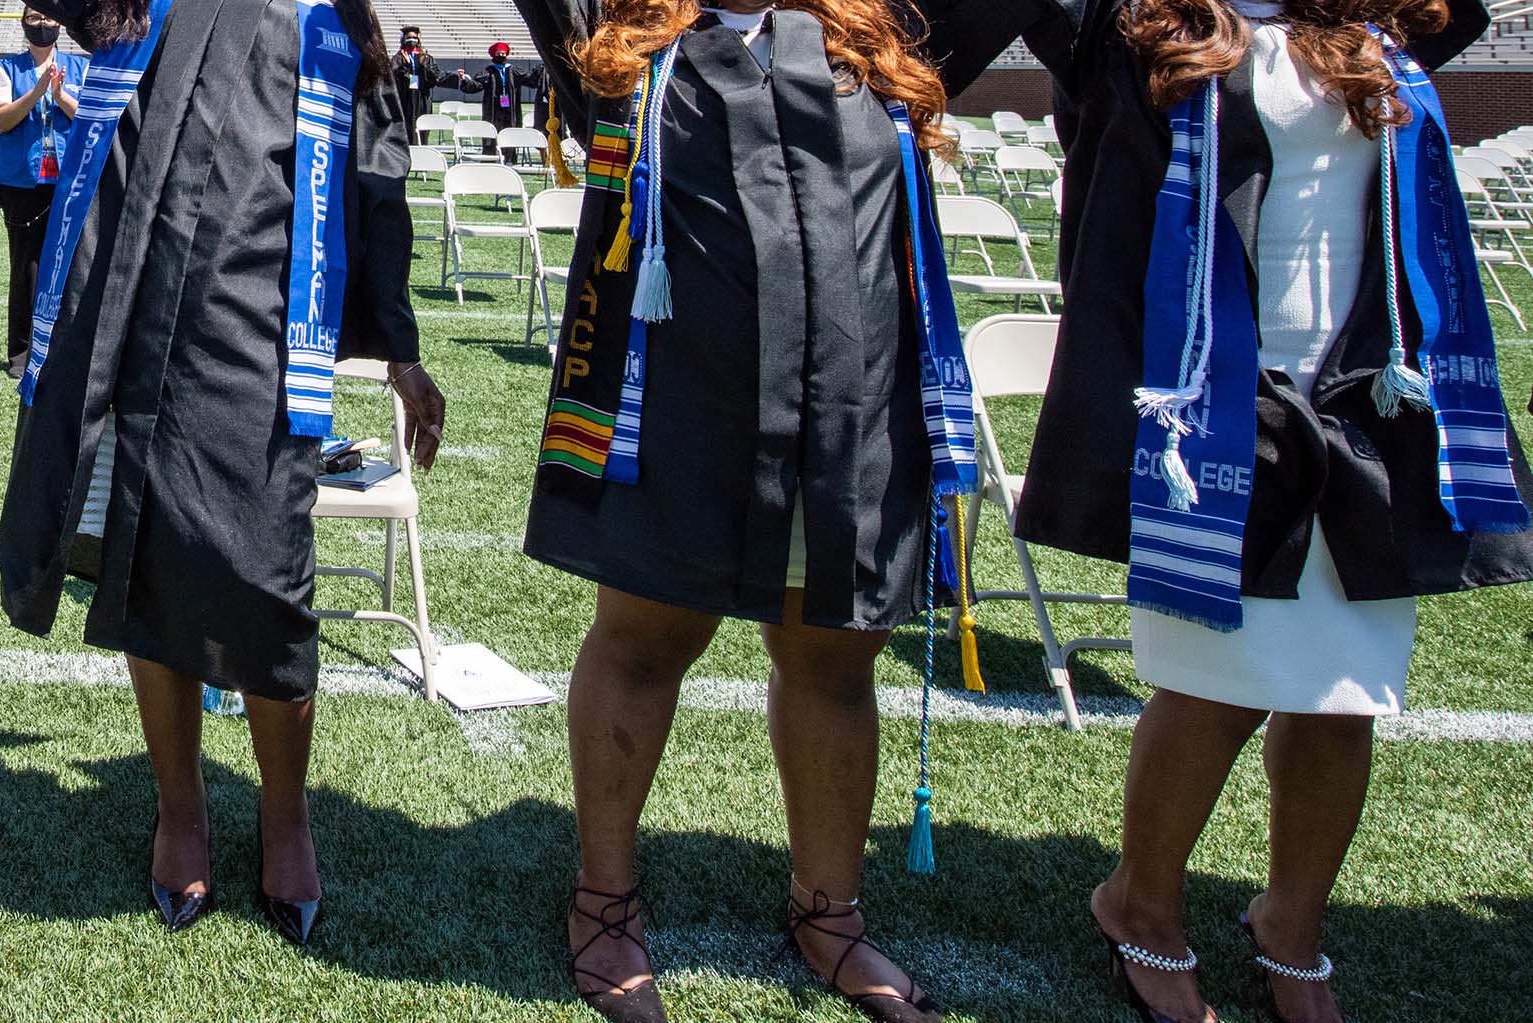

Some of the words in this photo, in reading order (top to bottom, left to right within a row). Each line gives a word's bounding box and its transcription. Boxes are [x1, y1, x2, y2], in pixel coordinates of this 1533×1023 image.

[48, 121, 103, 294] SPELMAN
[307, 140, 329, 324] SPELMAN
[287, 321, 338, 353] COLLEGE
